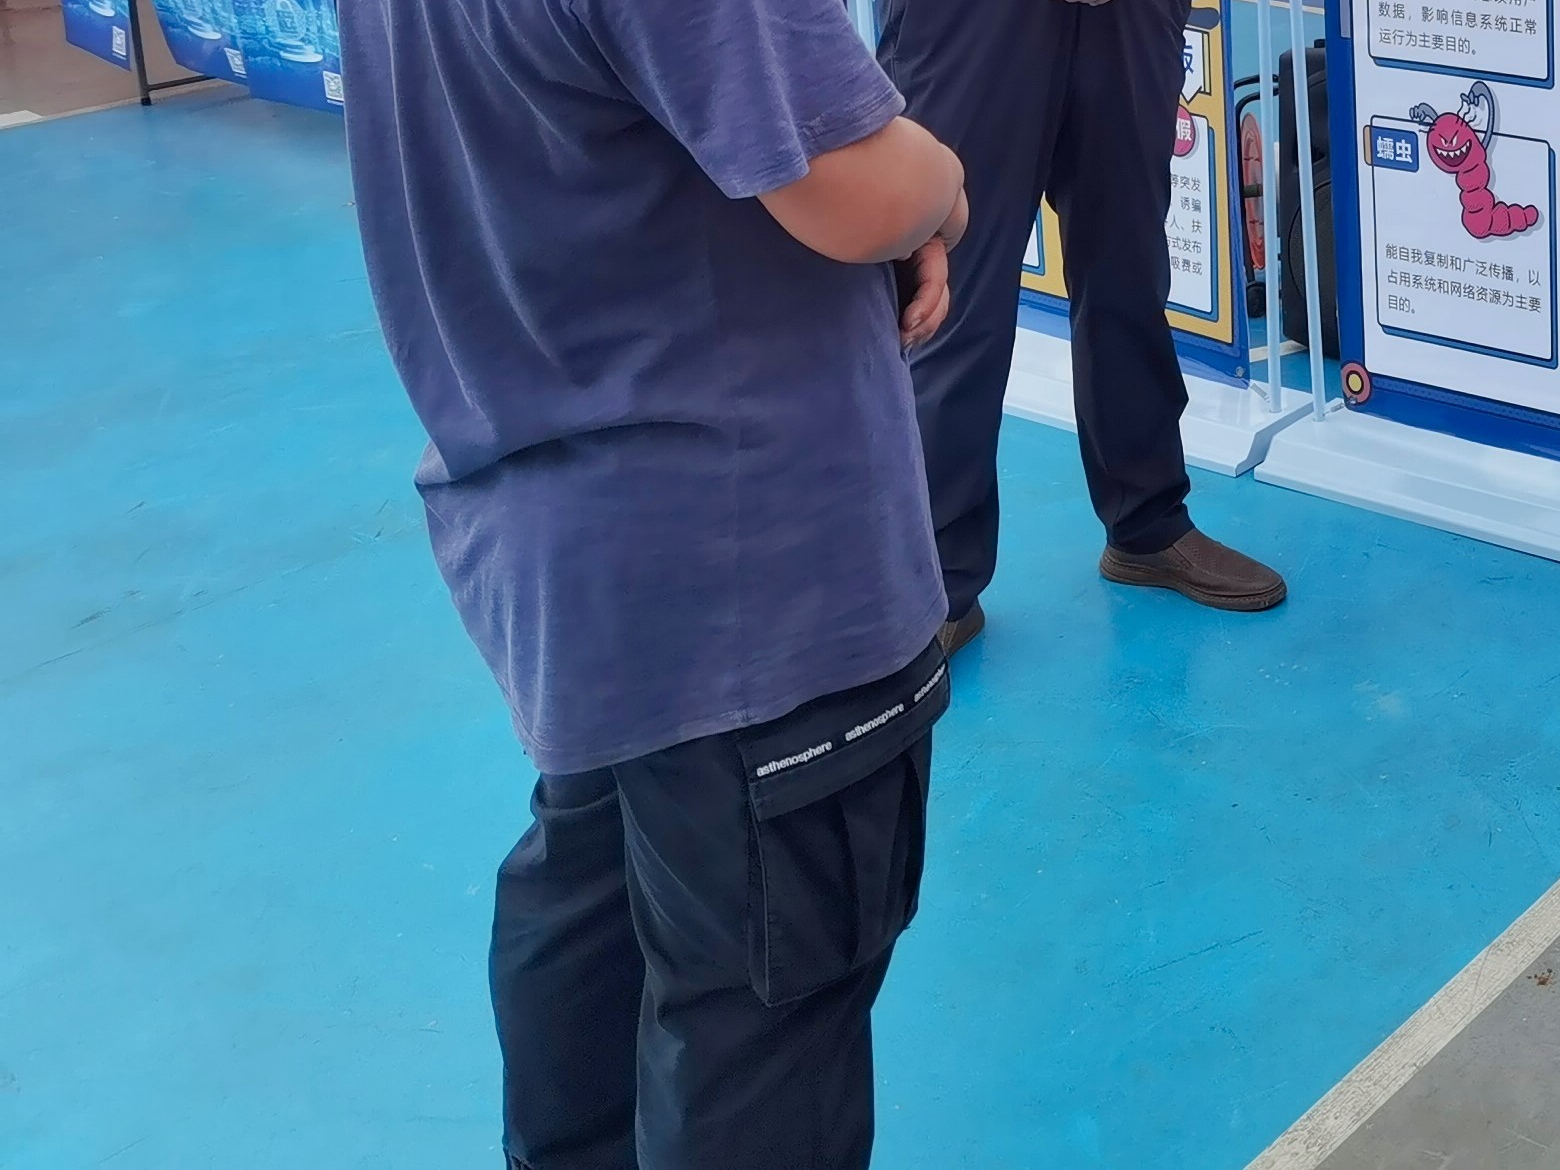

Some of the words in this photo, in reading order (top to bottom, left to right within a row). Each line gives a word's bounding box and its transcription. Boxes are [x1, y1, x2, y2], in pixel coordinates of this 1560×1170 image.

[1378, 27, 1478, 56] 运行为主要目的。
[1376, 136, 1413, 164] 蠕虫
[1385, 243, 1541, 288] 能自我复制和广泛传播，以
[1386, 269, 1542, 314] 占用系统和网络资源为主要
[1388, 294, 1418, 316] 目的。
[756, 740, 833, 777] asthenosphere
